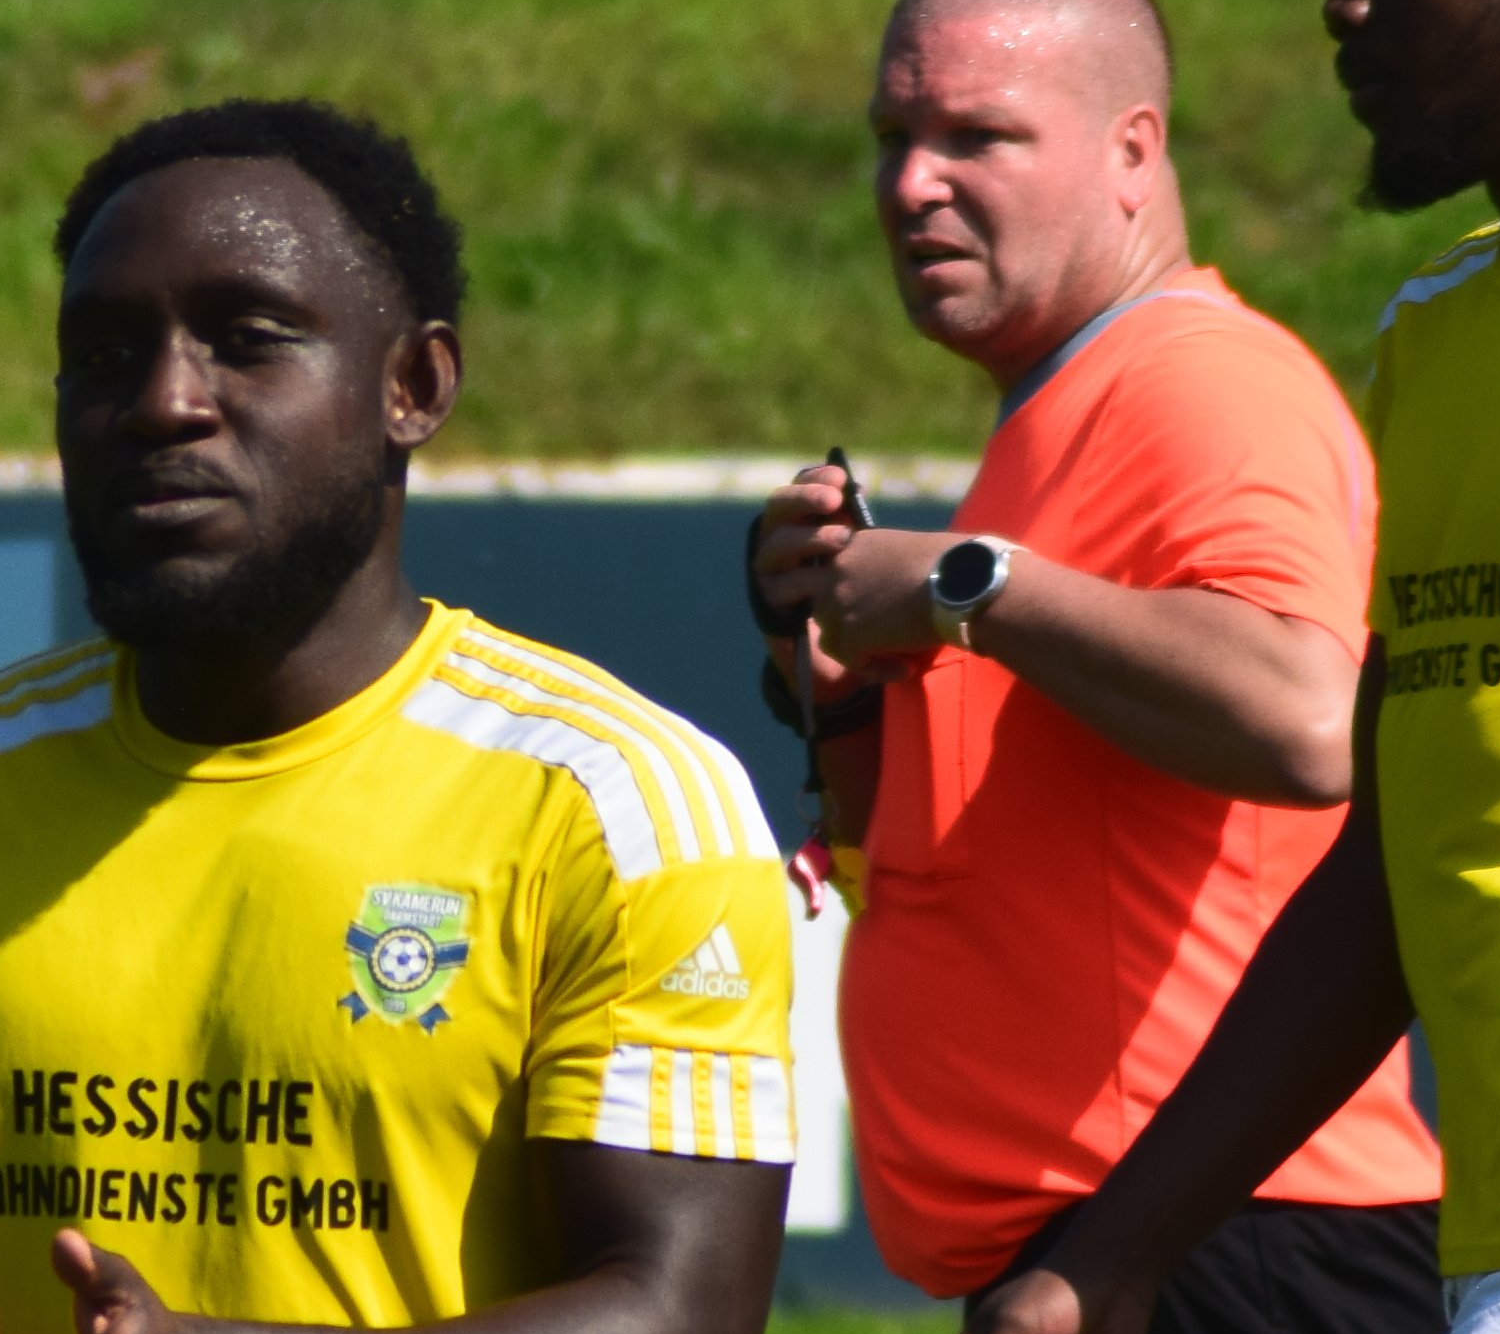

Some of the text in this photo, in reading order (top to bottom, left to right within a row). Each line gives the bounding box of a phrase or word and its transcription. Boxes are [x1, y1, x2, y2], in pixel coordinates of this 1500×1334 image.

[659, 970, 750, 1000] adidas
[12, 1069, 314, 1147] HESSISCHE
[256, 1175, 389, 1232] GMBH
